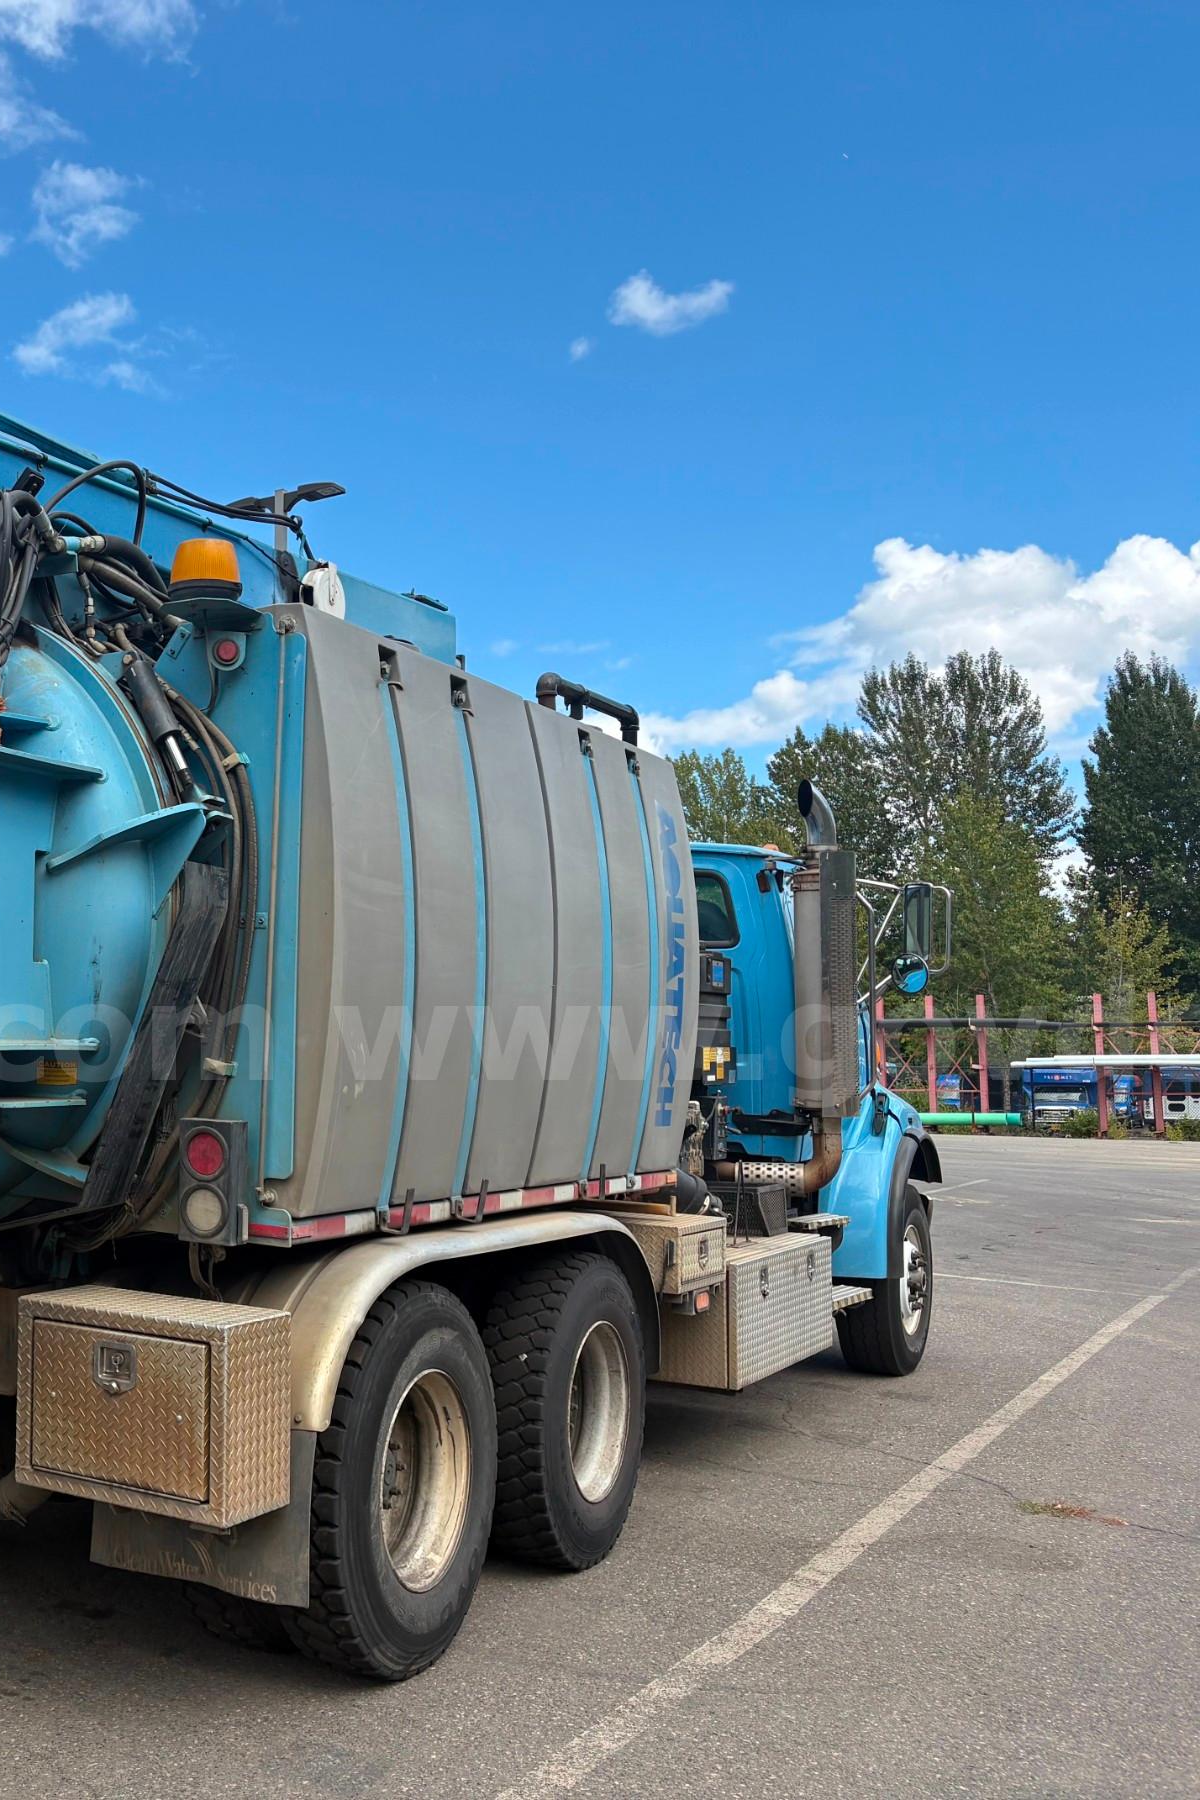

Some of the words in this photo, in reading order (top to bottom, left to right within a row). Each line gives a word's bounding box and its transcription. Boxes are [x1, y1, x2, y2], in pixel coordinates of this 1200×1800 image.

[655, 800, 685, 1128] AQUATECH
[39, 1061, 76, 1069] CAUTION
[216, 1563, 278, 1603] Services
